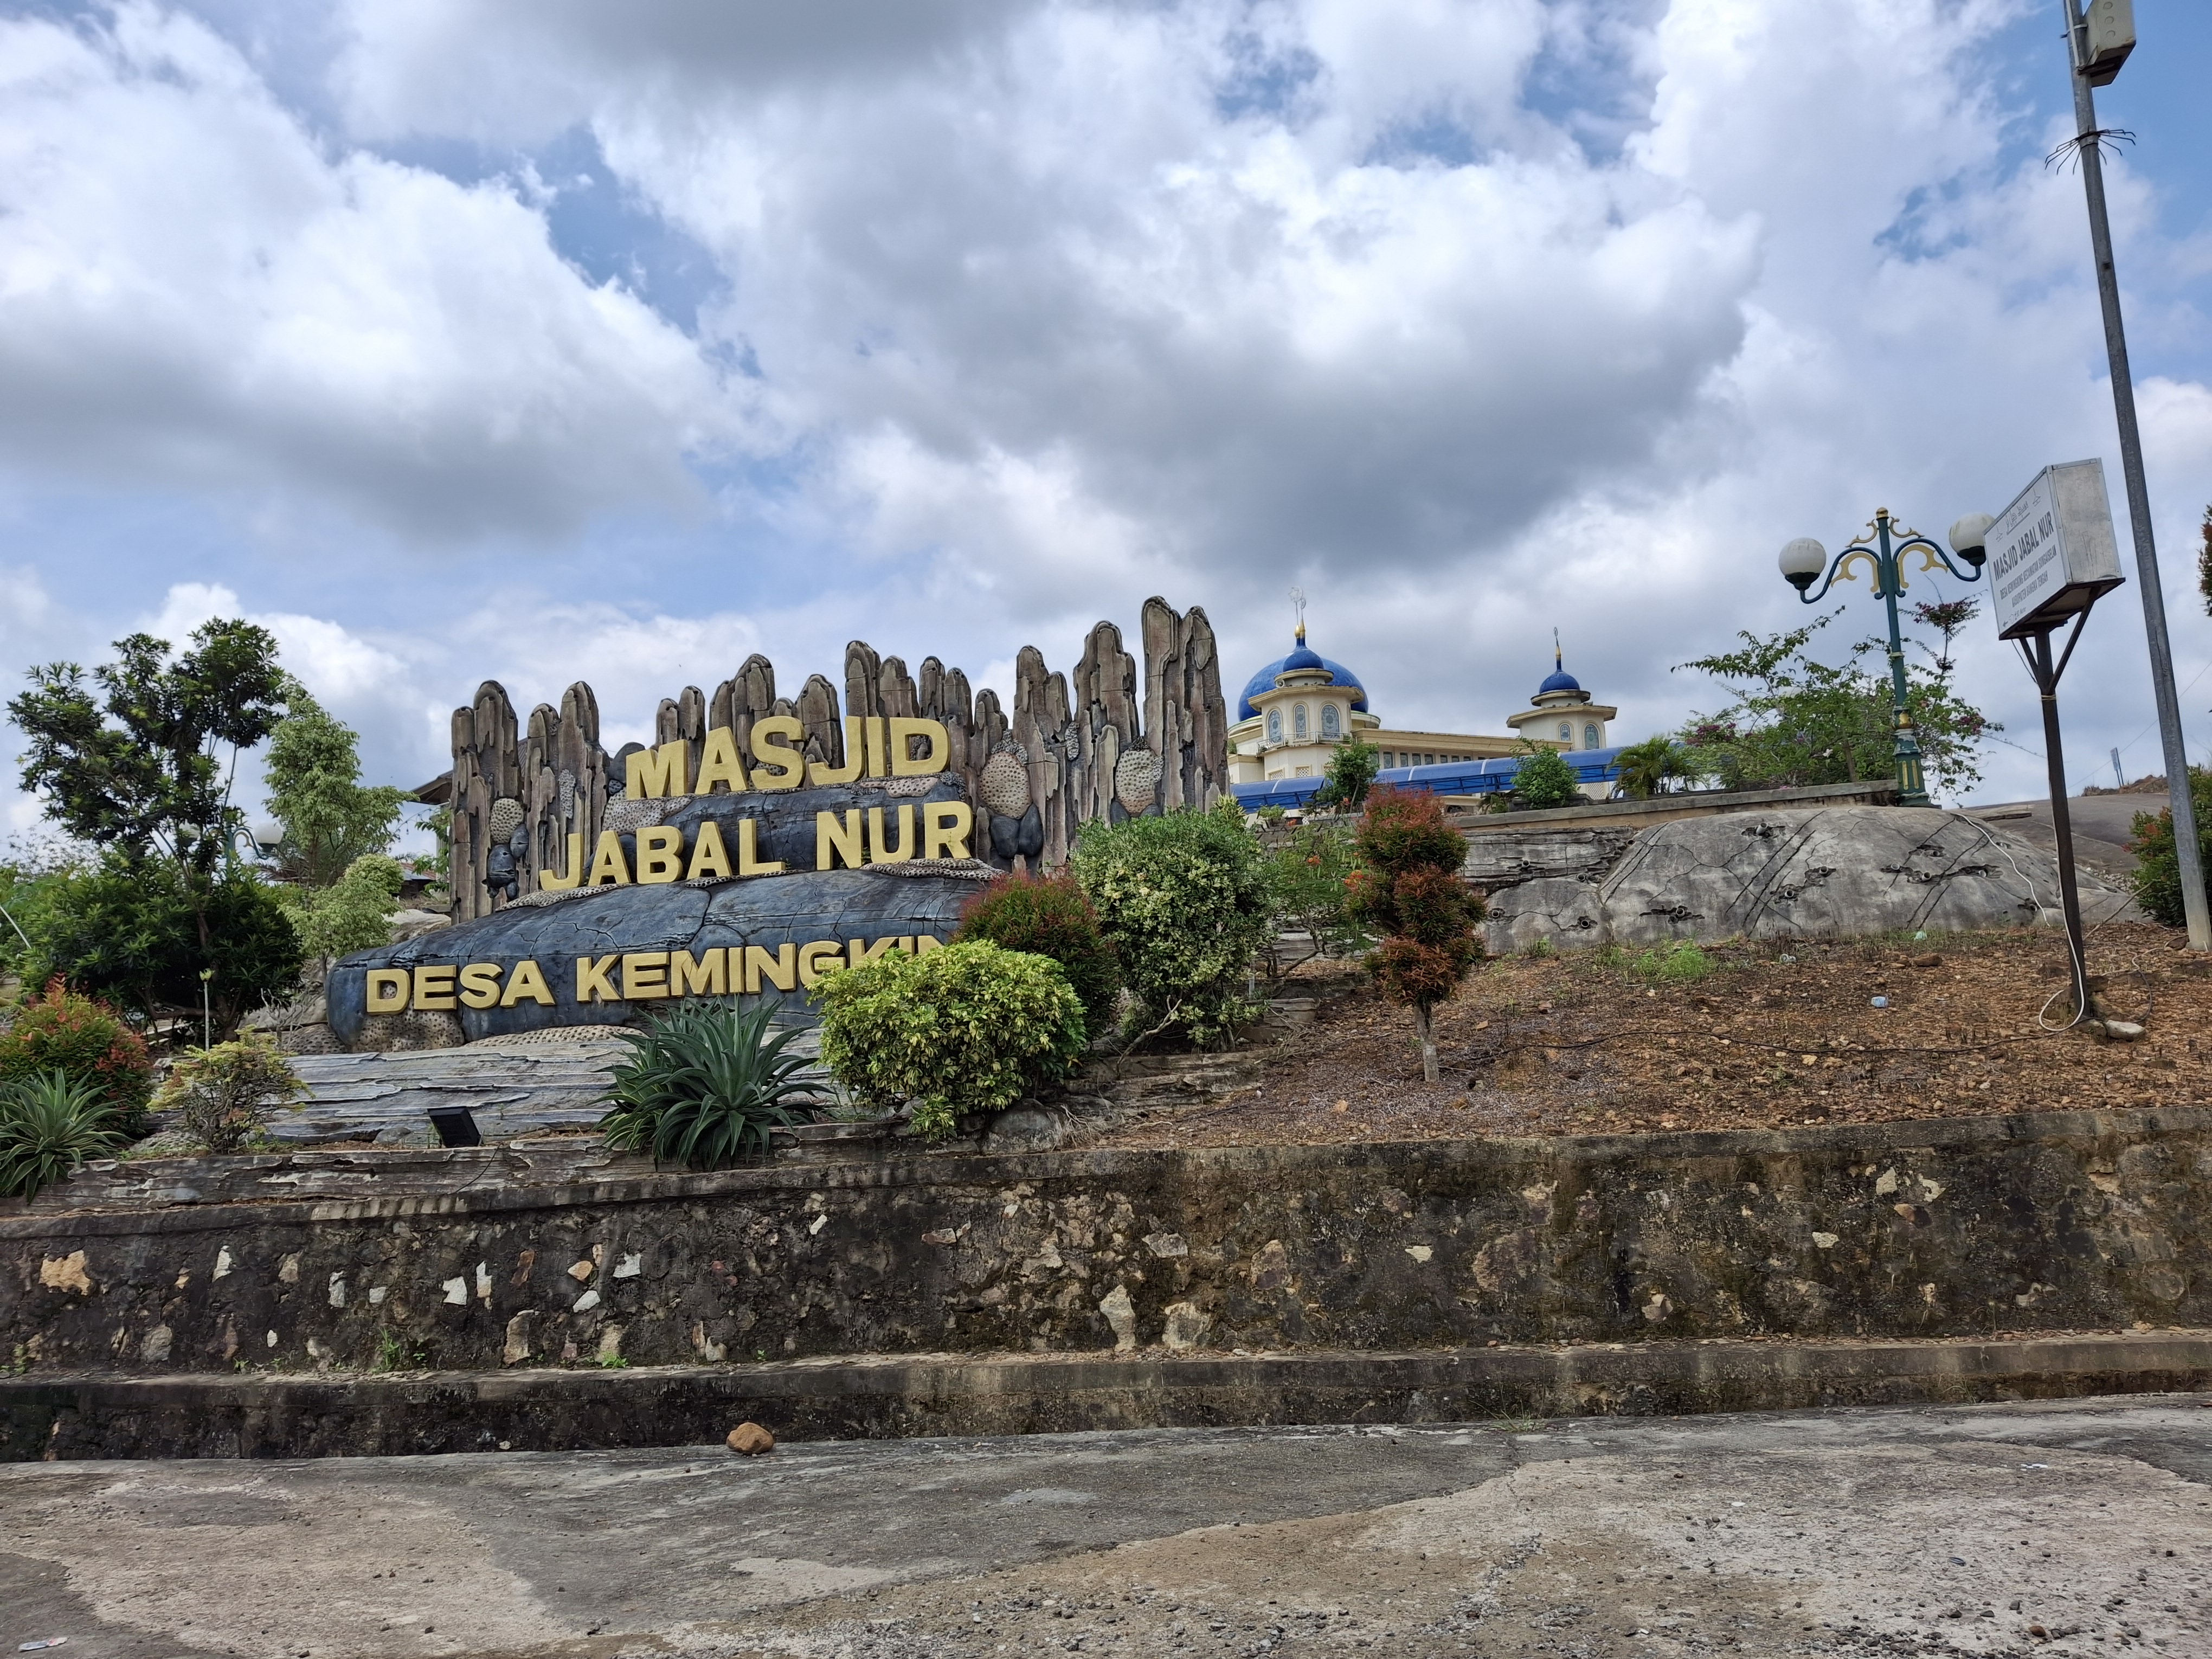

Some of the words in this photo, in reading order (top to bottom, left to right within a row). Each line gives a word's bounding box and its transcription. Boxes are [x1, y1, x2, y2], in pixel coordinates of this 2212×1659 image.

[1993, 544, 2018, 582] MASJID
[2018, 525, 2040, 561] JABAL
[2037, 511, 2054, 543] NUR
[1999, 586, 2008, 600] DESA
[2027, 579, 2038, 597] BANGKA
[2037, 570, 2048, 588] TENGAH
[626, 715, 951, 800] MASJID
[539, 819, 786, 891] JABAL
[816, 801, 973, 870] NUR
[366, 960, 556, 1015] DESA
